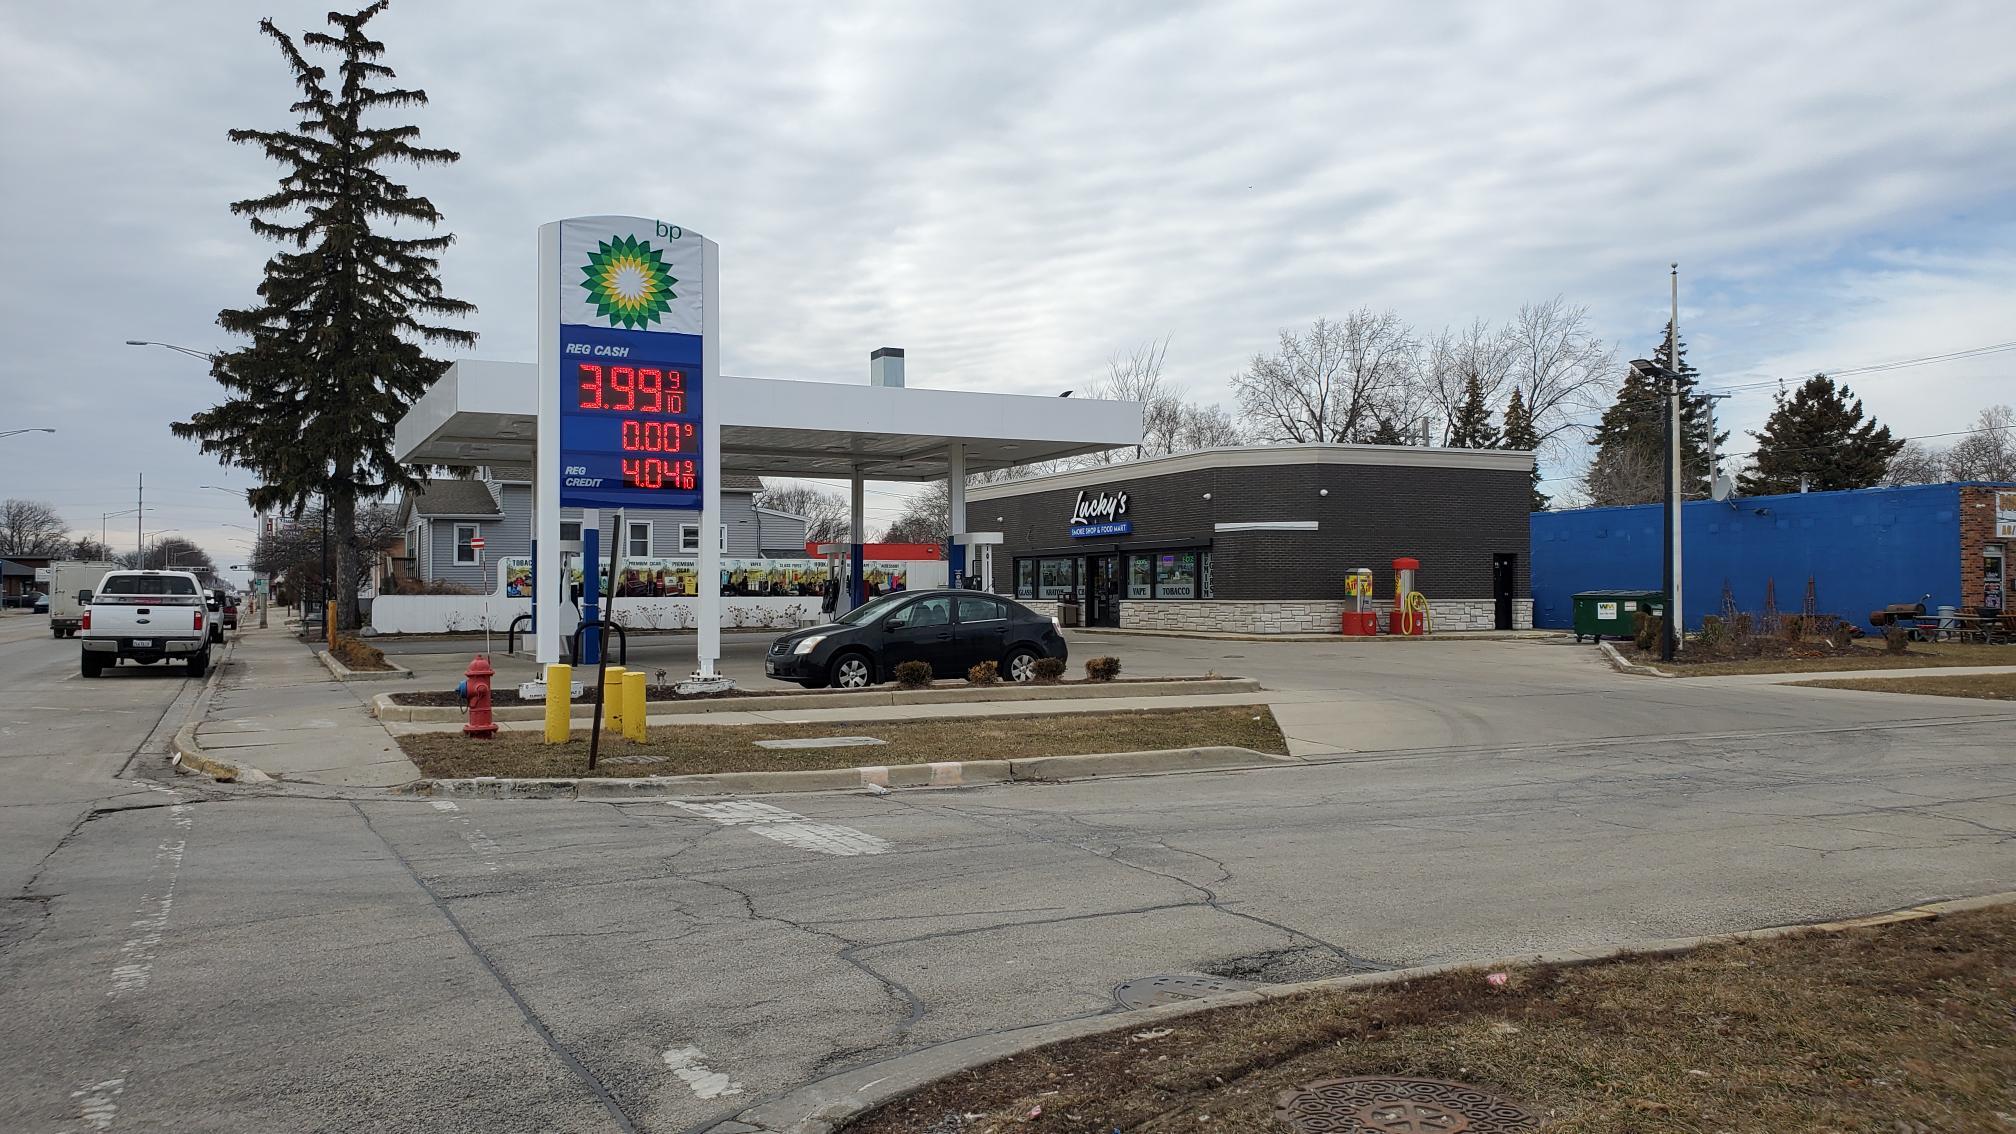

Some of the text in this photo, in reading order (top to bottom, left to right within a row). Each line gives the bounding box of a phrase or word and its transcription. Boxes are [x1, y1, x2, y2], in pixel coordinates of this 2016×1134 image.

[655, 219, 682, 243] bp
[566, 343, 630, 358] REG CASH
[579, 364, 680, 413] 3.99 9
[667, 394, 681, 414] 10
[622, 420, 693, 453] 0.00 9
[565, 466, 586, 475] REG
[622, 458, 680, 489] 4.04
[565, 478, 602, 488] CREDIT
[1070, 490, 1127, 524] Lucky's
[1071, 527, 1086, 536] SMOKE
[1085, 527, 1097, 535] SHOP
[1100, 525, 1114, 533] FOOD
[1113, 524, 1127, 532] MART
[1132, 587, 1147, 596] VAPE
[1162, 587, 1191, 596] TOBACCO
